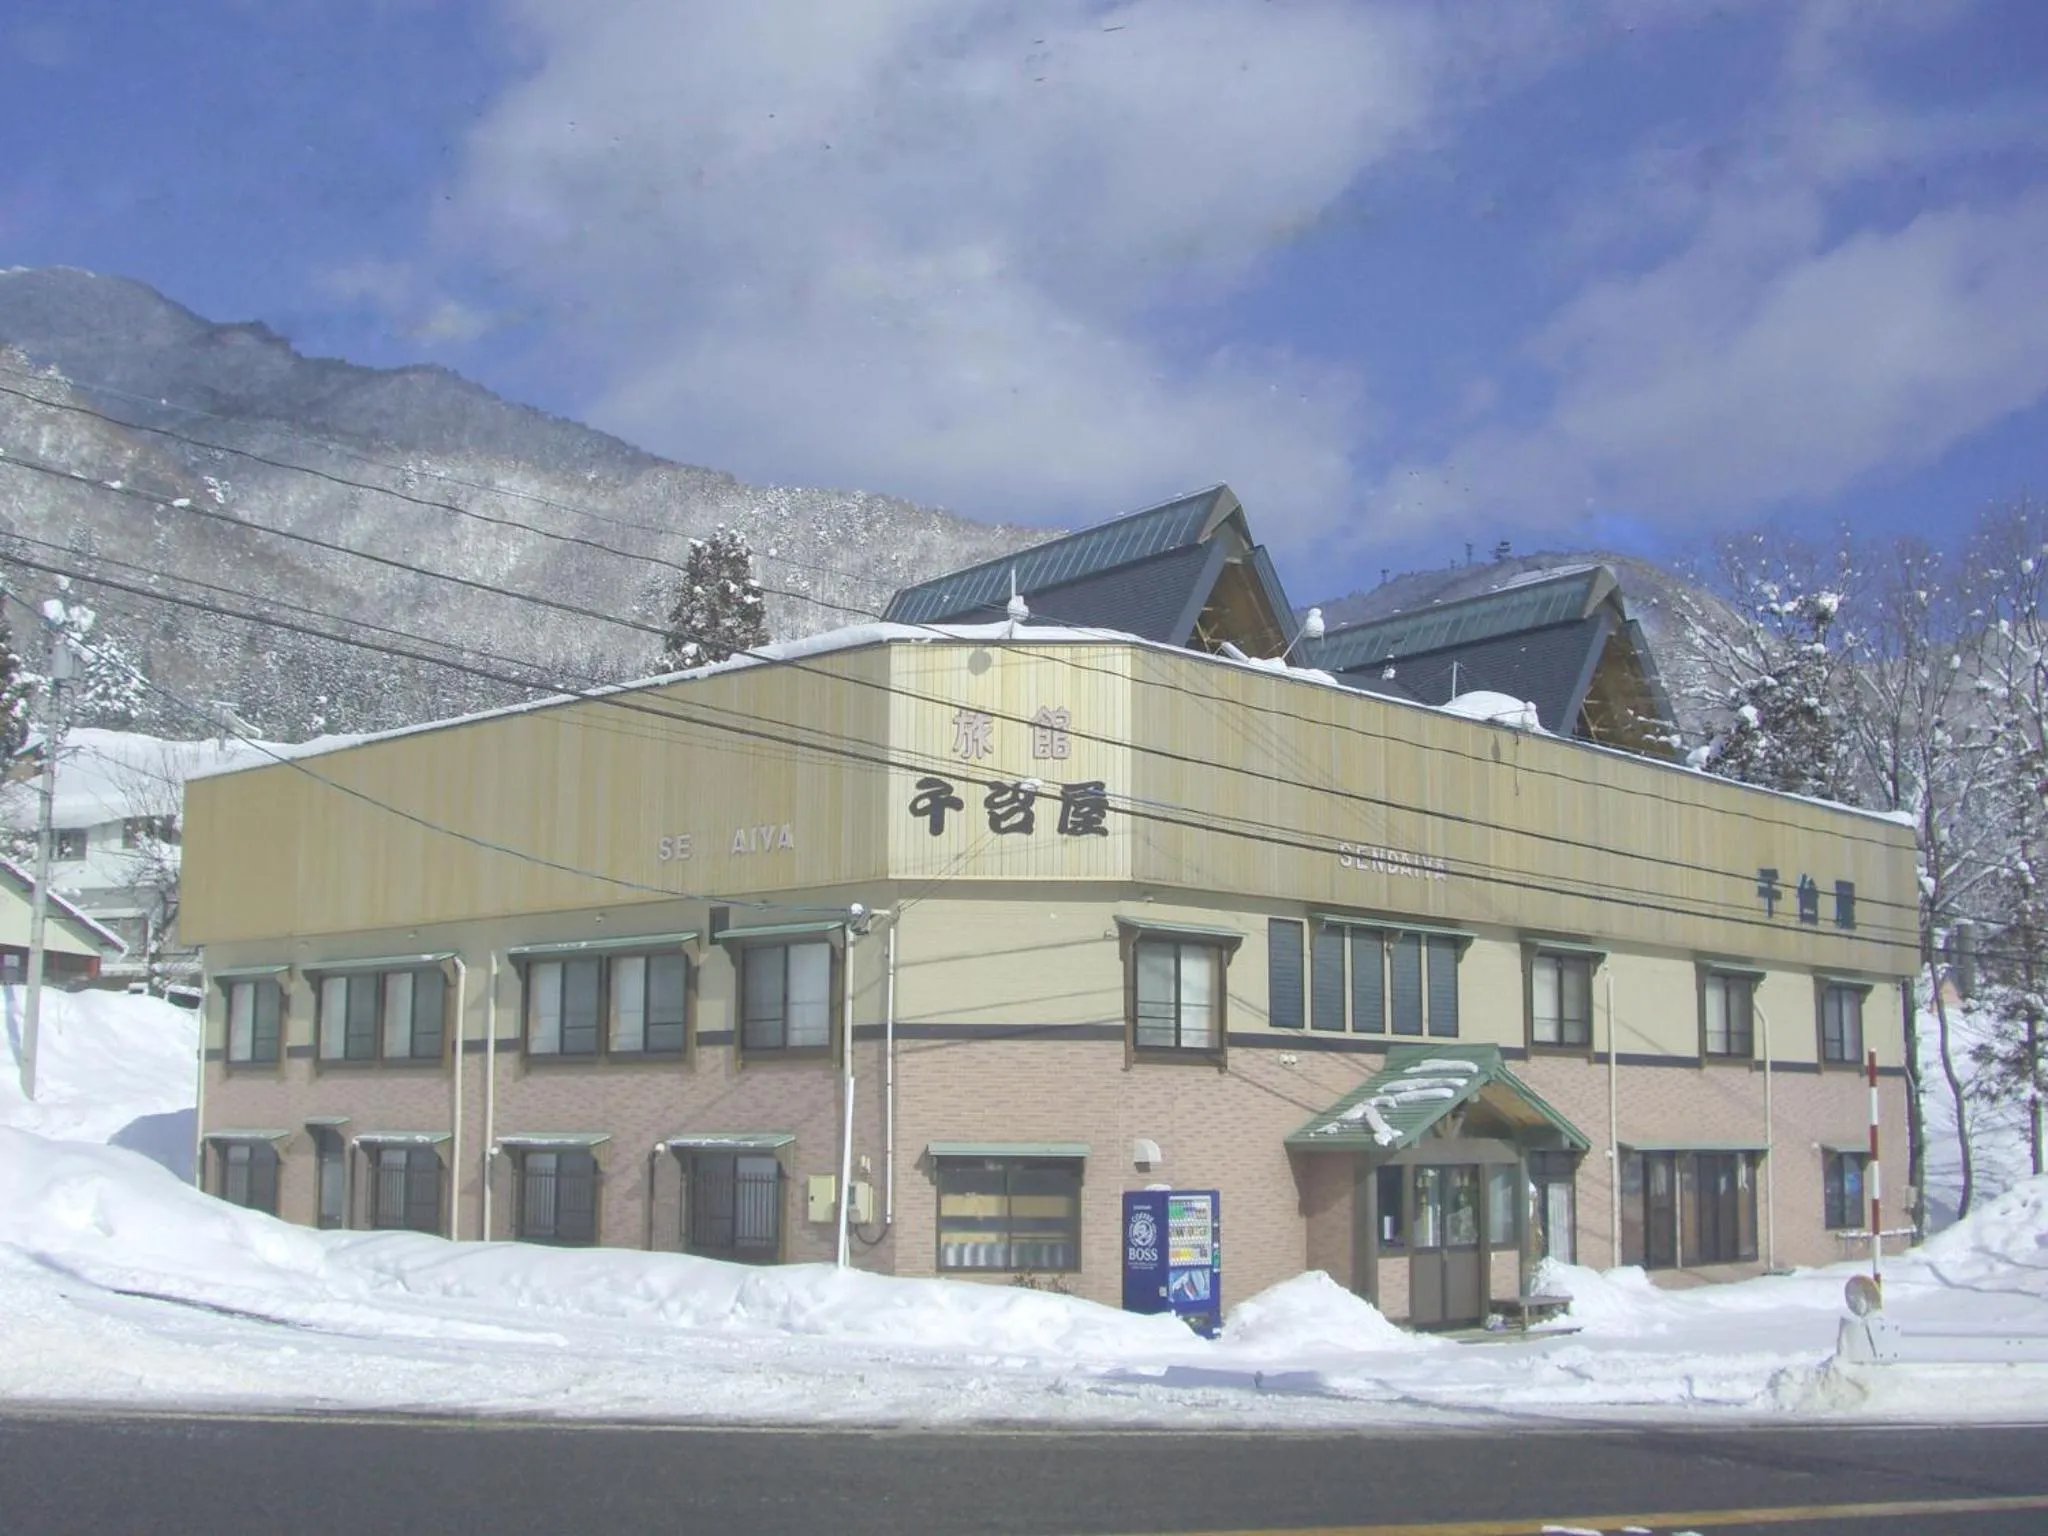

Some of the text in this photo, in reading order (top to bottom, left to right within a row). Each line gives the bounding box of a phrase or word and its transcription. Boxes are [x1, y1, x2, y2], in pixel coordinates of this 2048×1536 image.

[952, 706, 1072, 760] 旅館
[659, 822, 794, 862] SE AIYA
[1339, 841, 1448, 881] SENDAIYA
[1128, 1247, 1158, 1261] BOSS
